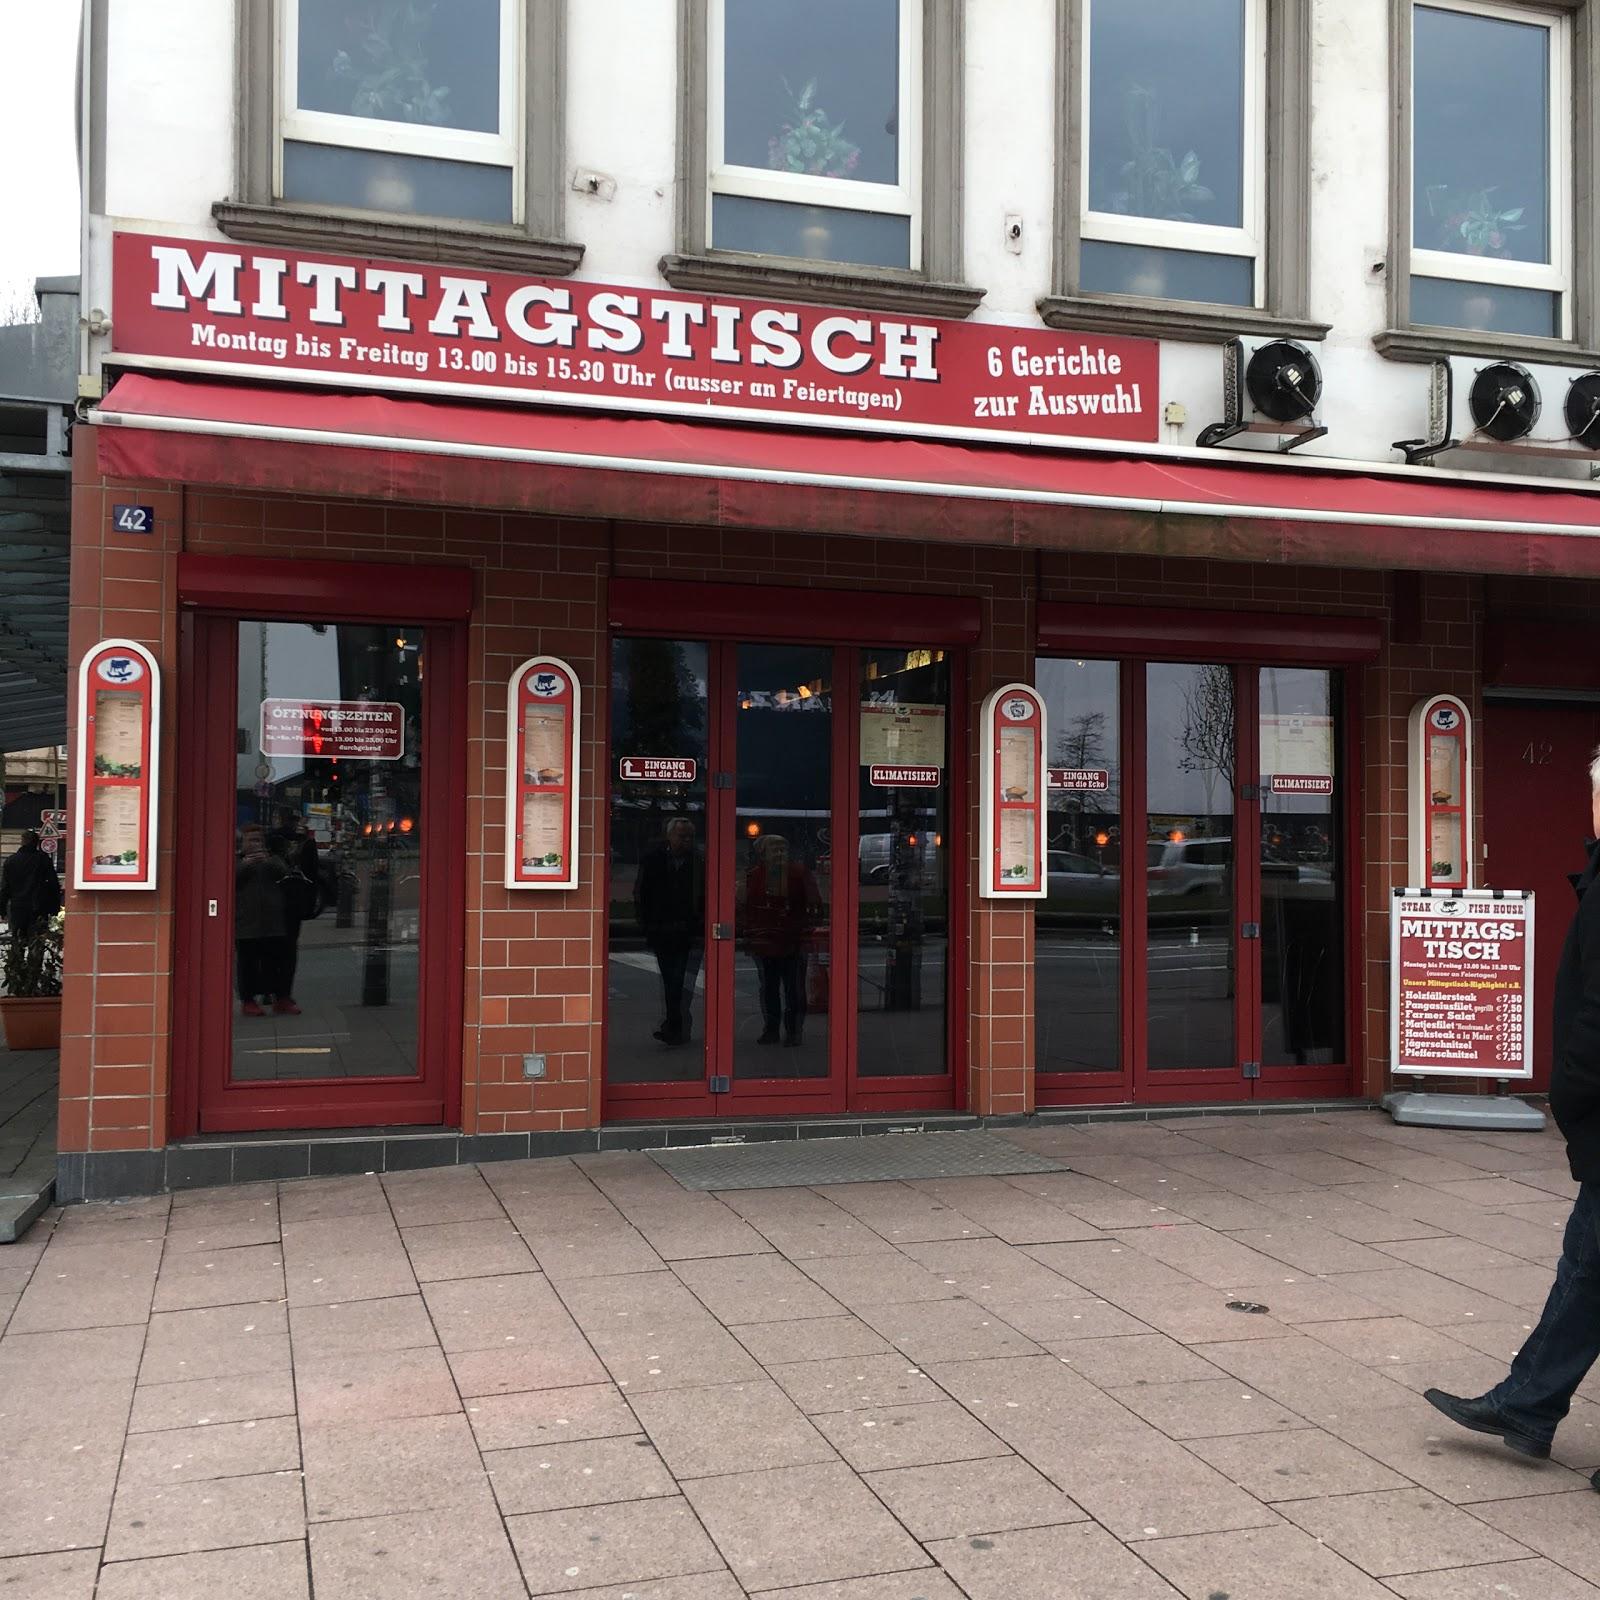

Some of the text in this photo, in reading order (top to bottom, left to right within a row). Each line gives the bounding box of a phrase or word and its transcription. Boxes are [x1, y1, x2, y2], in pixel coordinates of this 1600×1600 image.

[150, 245, 939, 381] MITTAGSTISCH
[987, 344, 1122, 377] 6 Gerichte
[191, 323, 903, 411] Montag bis Freitag 13.00 bis 15.30 Uhr (ausser an Feiertagen)
[974, 384, 1142, 417] zur Auswahl
[119, 508, 146, 530] 42
[644, 760, 686, 770] EINGANG
[658, 770, 671, 778] die
[873, 769, 938, 781] KLIMATISIERT
[1063, 771, 1100, 781] EINGANG
[1075, 780, 1087, 788] die
[1088, 780, 1105, 788] Ecke
[1273, 778, 1331, 789] KLIMATISIERT
[1401, 902, 1524, 915] STEAK FISH HOUSE
[1401, 919, 1524, 941] MITTAGS-
[1423, 941, 1501, 960] TISCH
[1405, 990, 1477, 1002] Holzfällersteak
[1405, 1010, 1444, 1020] Farmer
[1447, 1011, 1476, 1020] Salat
[1405, 1020, 1454, 1031] Matjesfilet
[1405, 1029, 1454, 1039] Hacksteak
[1405, 1039, 1472, 1050] Jägerschnitzel
[1405, 1048, 1478, 1059] Pfefferschnitzel
